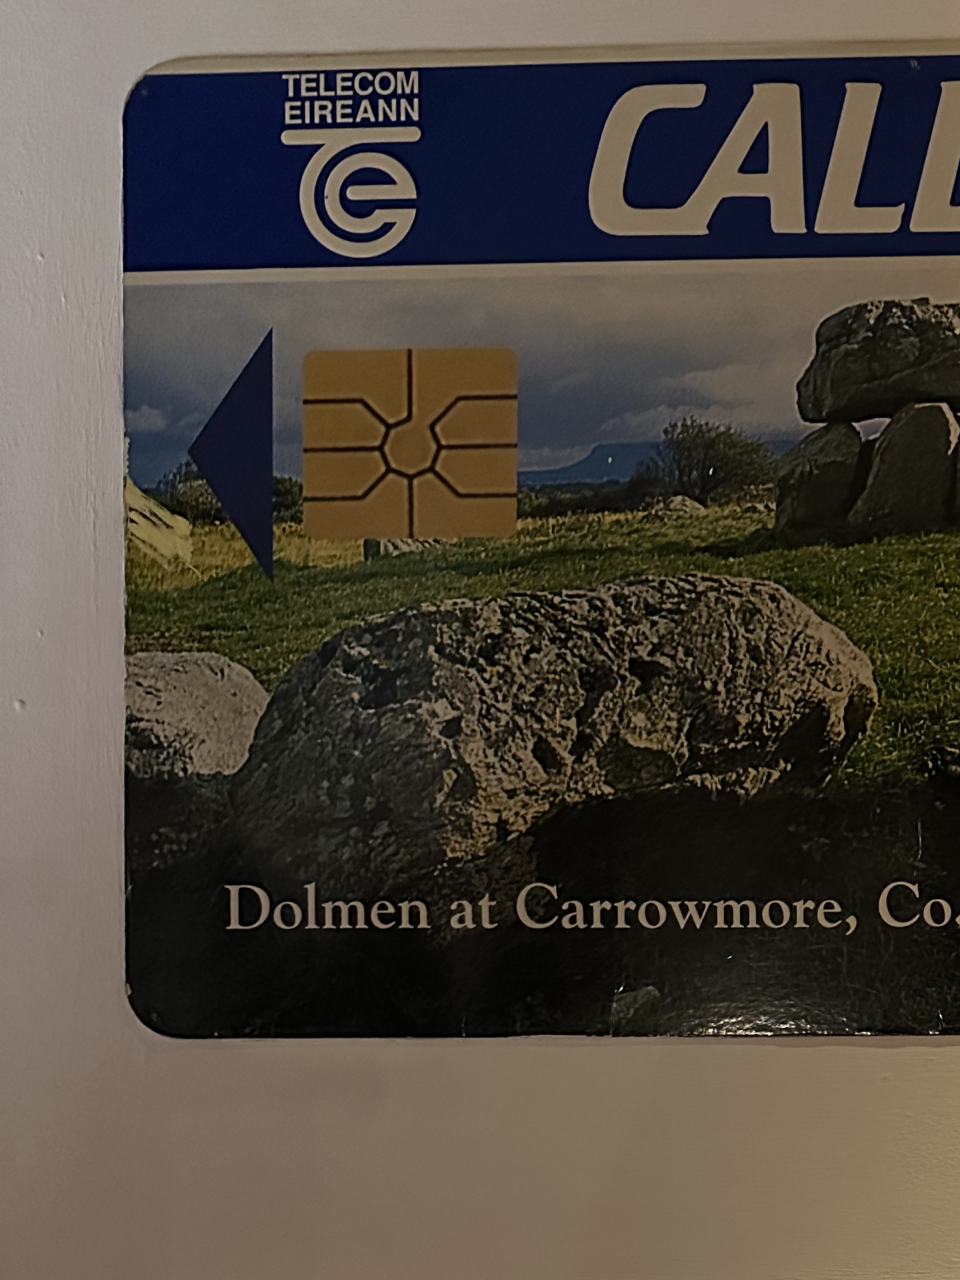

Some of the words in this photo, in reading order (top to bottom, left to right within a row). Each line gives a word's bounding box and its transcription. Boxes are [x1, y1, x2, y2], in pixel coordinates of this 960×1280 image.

[282, 70, 420, 98] TELECOM
[283, 98, 420, 124] EIREANN
[223, 881, 442, 932] Dolmen
[449, 892, 499, 931] at
[515, 881, 859, 936] Carrowmore,
